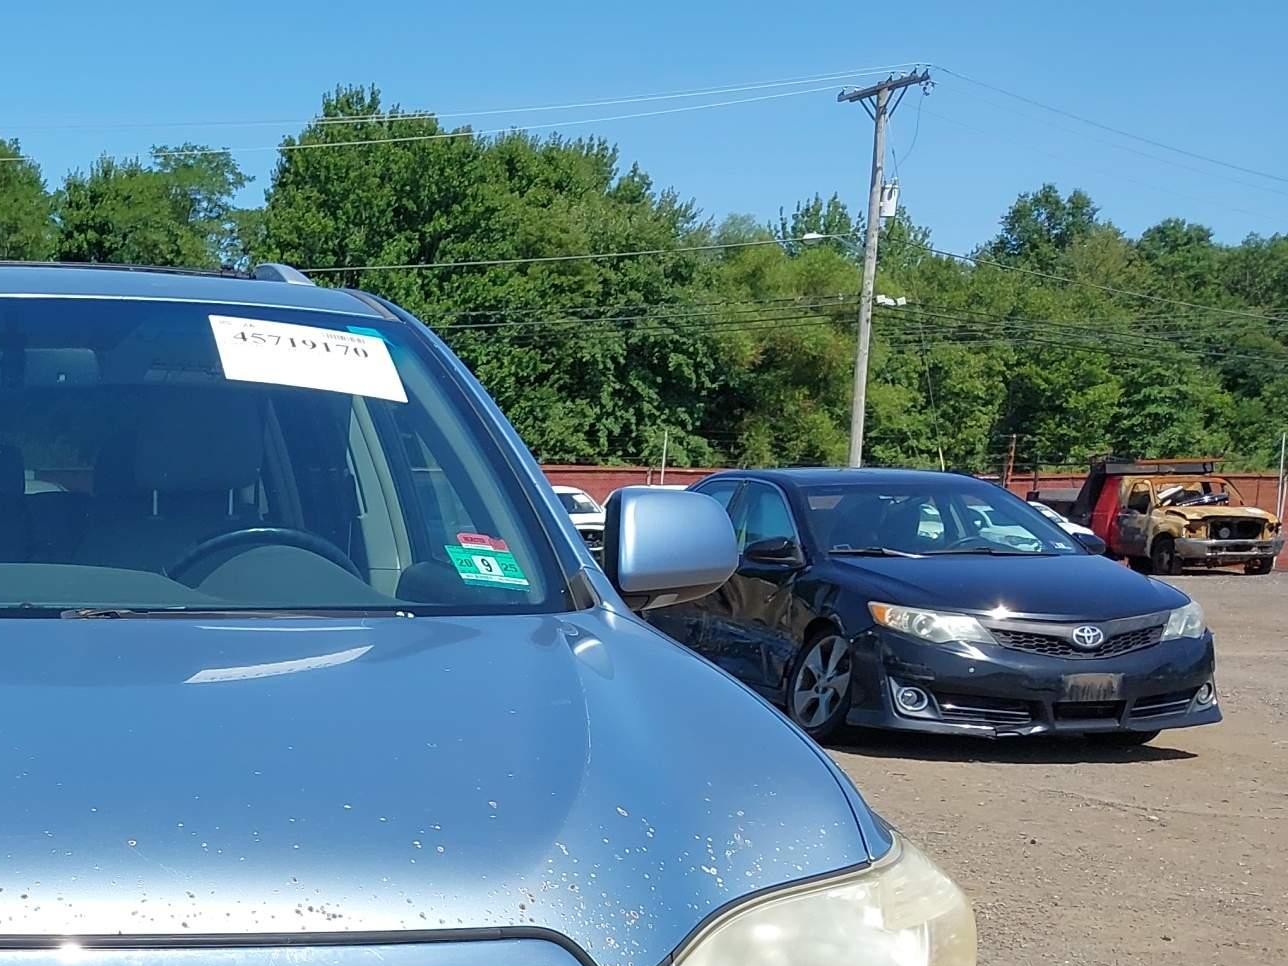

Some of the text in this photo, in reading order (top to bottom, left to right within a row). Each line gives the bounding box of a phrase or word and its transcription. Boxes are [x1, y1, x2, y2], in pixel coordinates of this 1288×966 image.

[233, 331, 369, 359] 45719170
[455, 557, 473, 568] 20
[481, 558, 493, 573] 9
